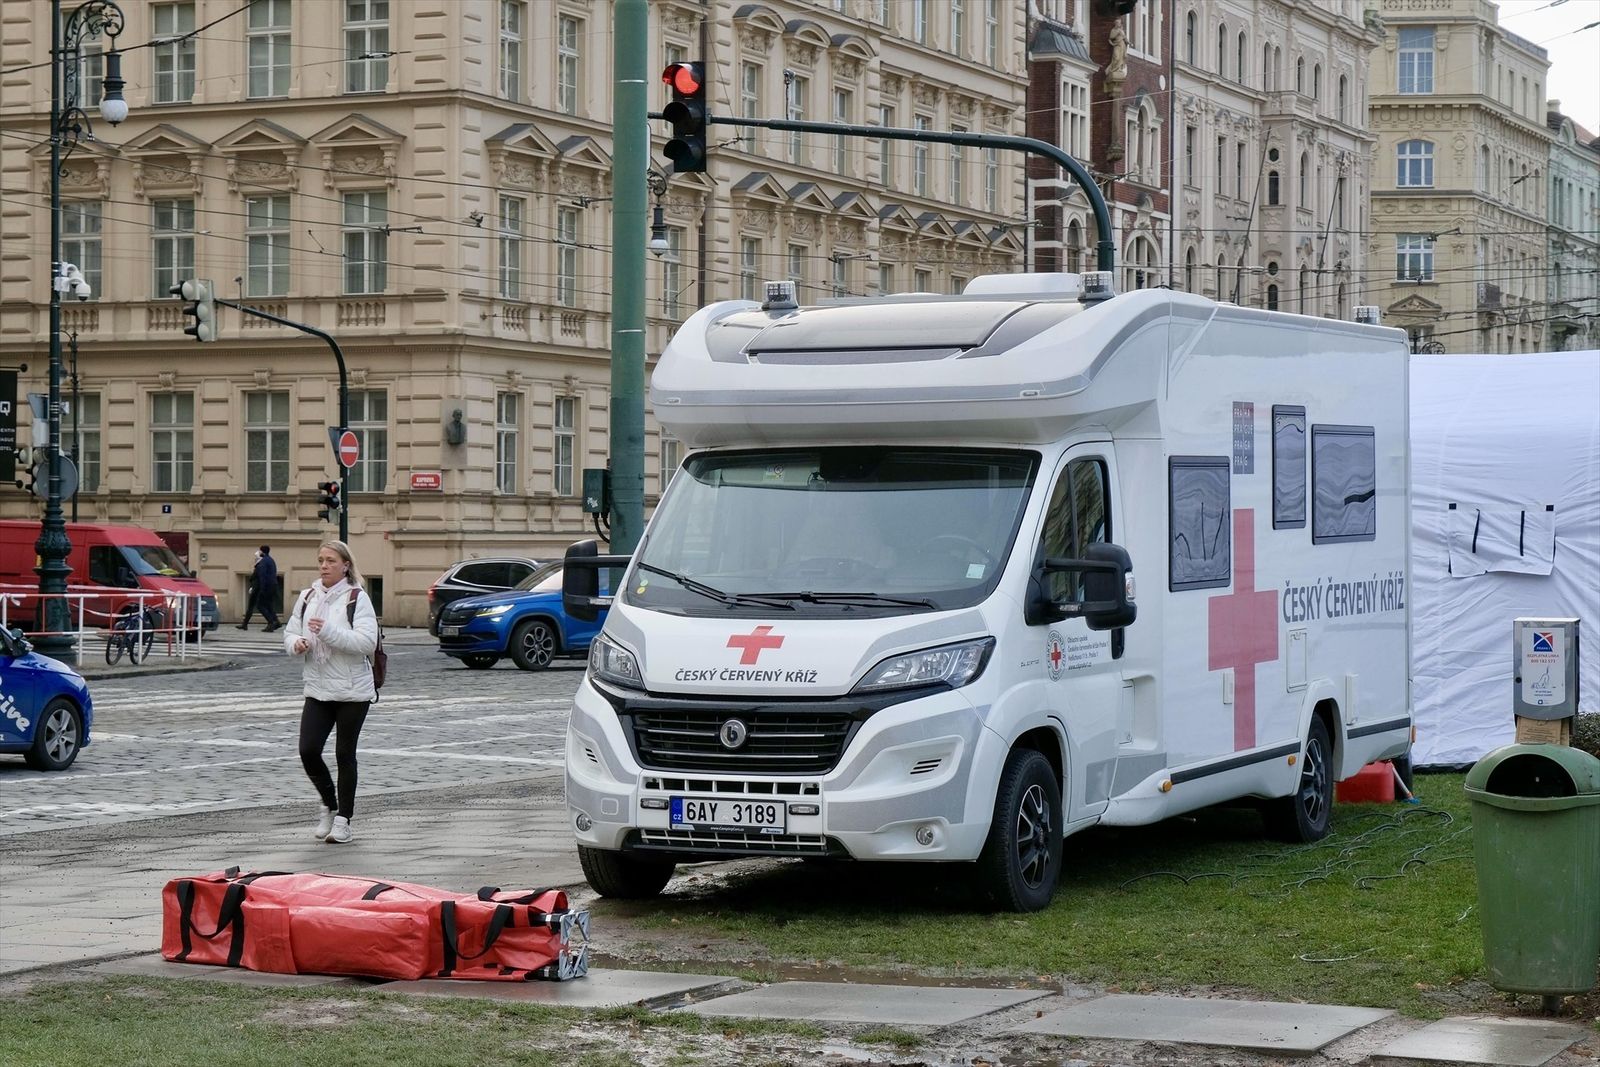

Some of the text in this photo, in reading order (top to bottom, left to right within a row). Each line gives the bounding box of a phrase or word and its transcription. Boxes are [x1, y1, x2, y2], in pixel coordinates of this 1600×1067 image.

[1283, 571, 1404, 623] ČESKÝ ČERVENÝ KŘÍŽ
[675, 668, 817, 683] ČESKÝ ČERVENÝ KŘÍŽ
[672, 813, 682, 821] CZ
[686, 801, 776, 824] 6AY 3189
